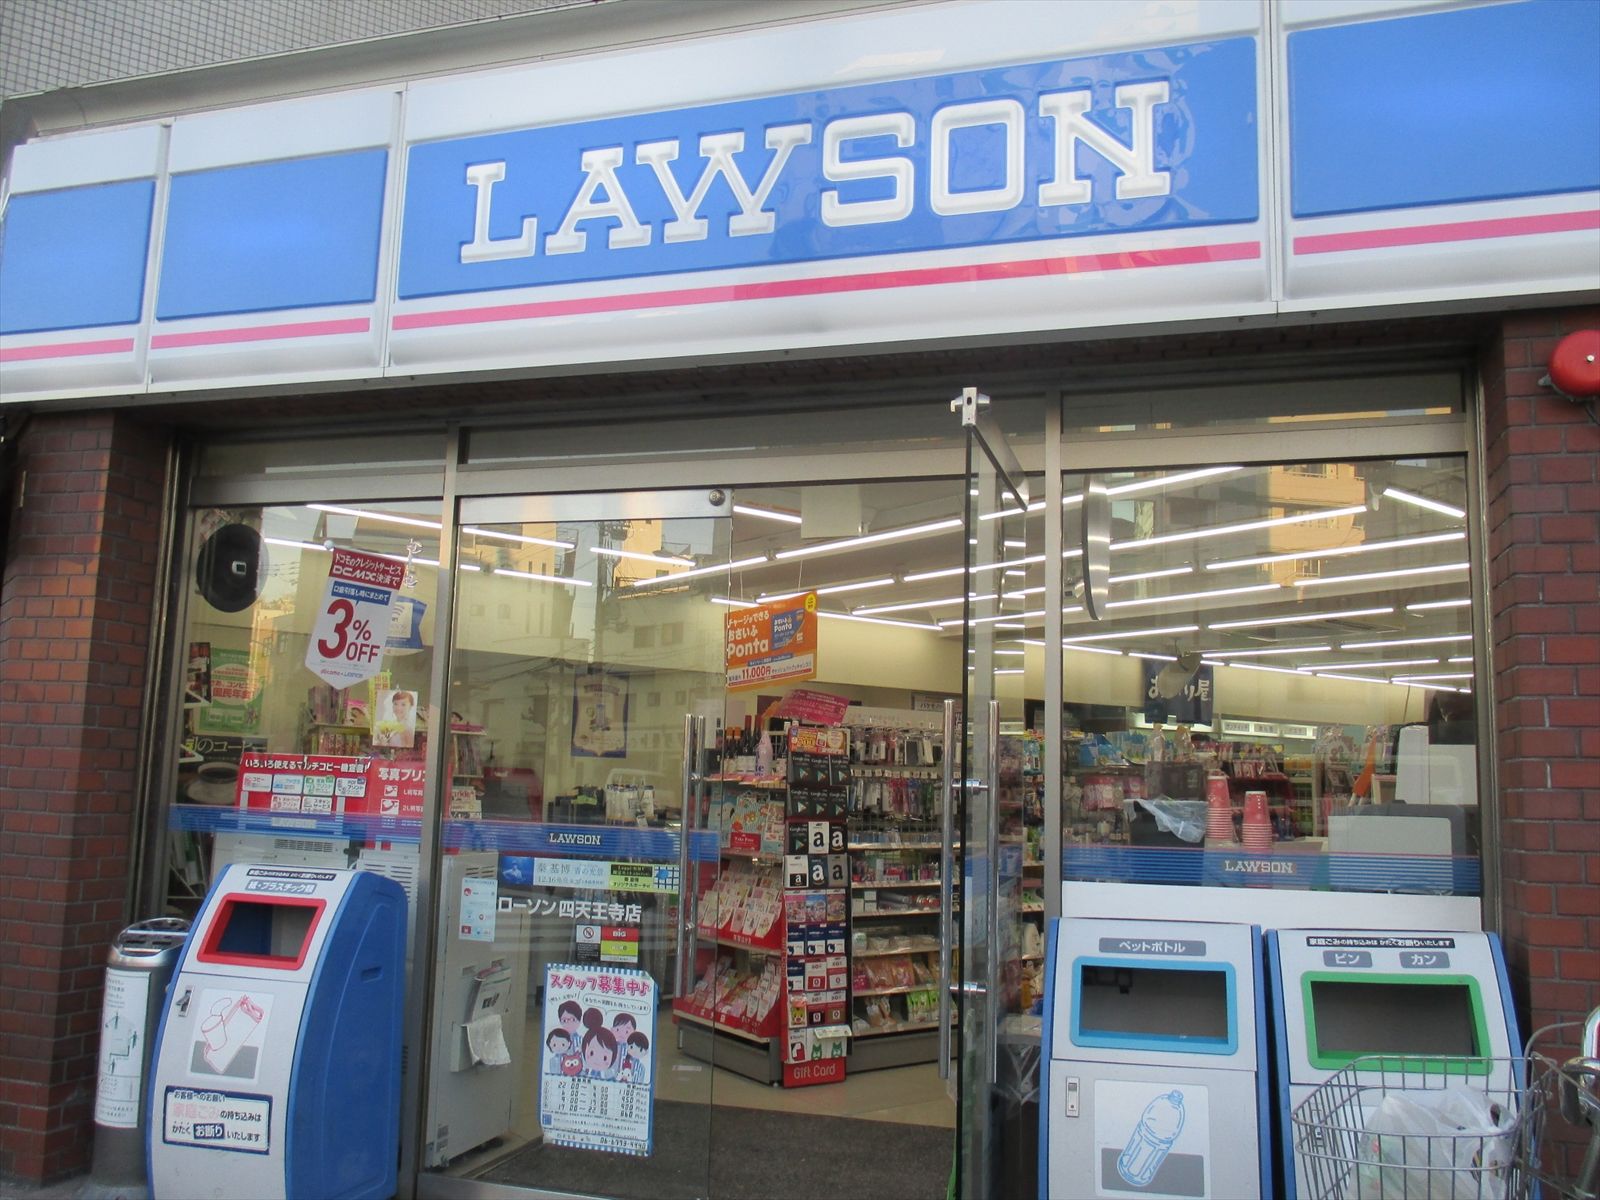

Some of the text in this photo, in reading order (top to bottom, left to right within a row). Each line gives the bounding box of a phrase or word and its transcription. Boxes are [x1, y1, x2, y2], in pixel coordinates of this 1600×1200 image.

[460, 80, 1171, 265] LAWSON
[335, 553, 402, 576] ドコモのクレジットサービス
[346, 642, 380, 663] OFF
[728, 639, 769, 659] Ponta
[549, 833, 602, 846] LAWSON
[1224, 859, 1295, 874] LAWSON
[1118, 940, 1186, 954] ペットボトル
[1334, 952, 1438, 966] ビン カン
[794, 1063, 836, 1080] Gift Card
[174, 1090, 226, 1103] お客様へのお願い
